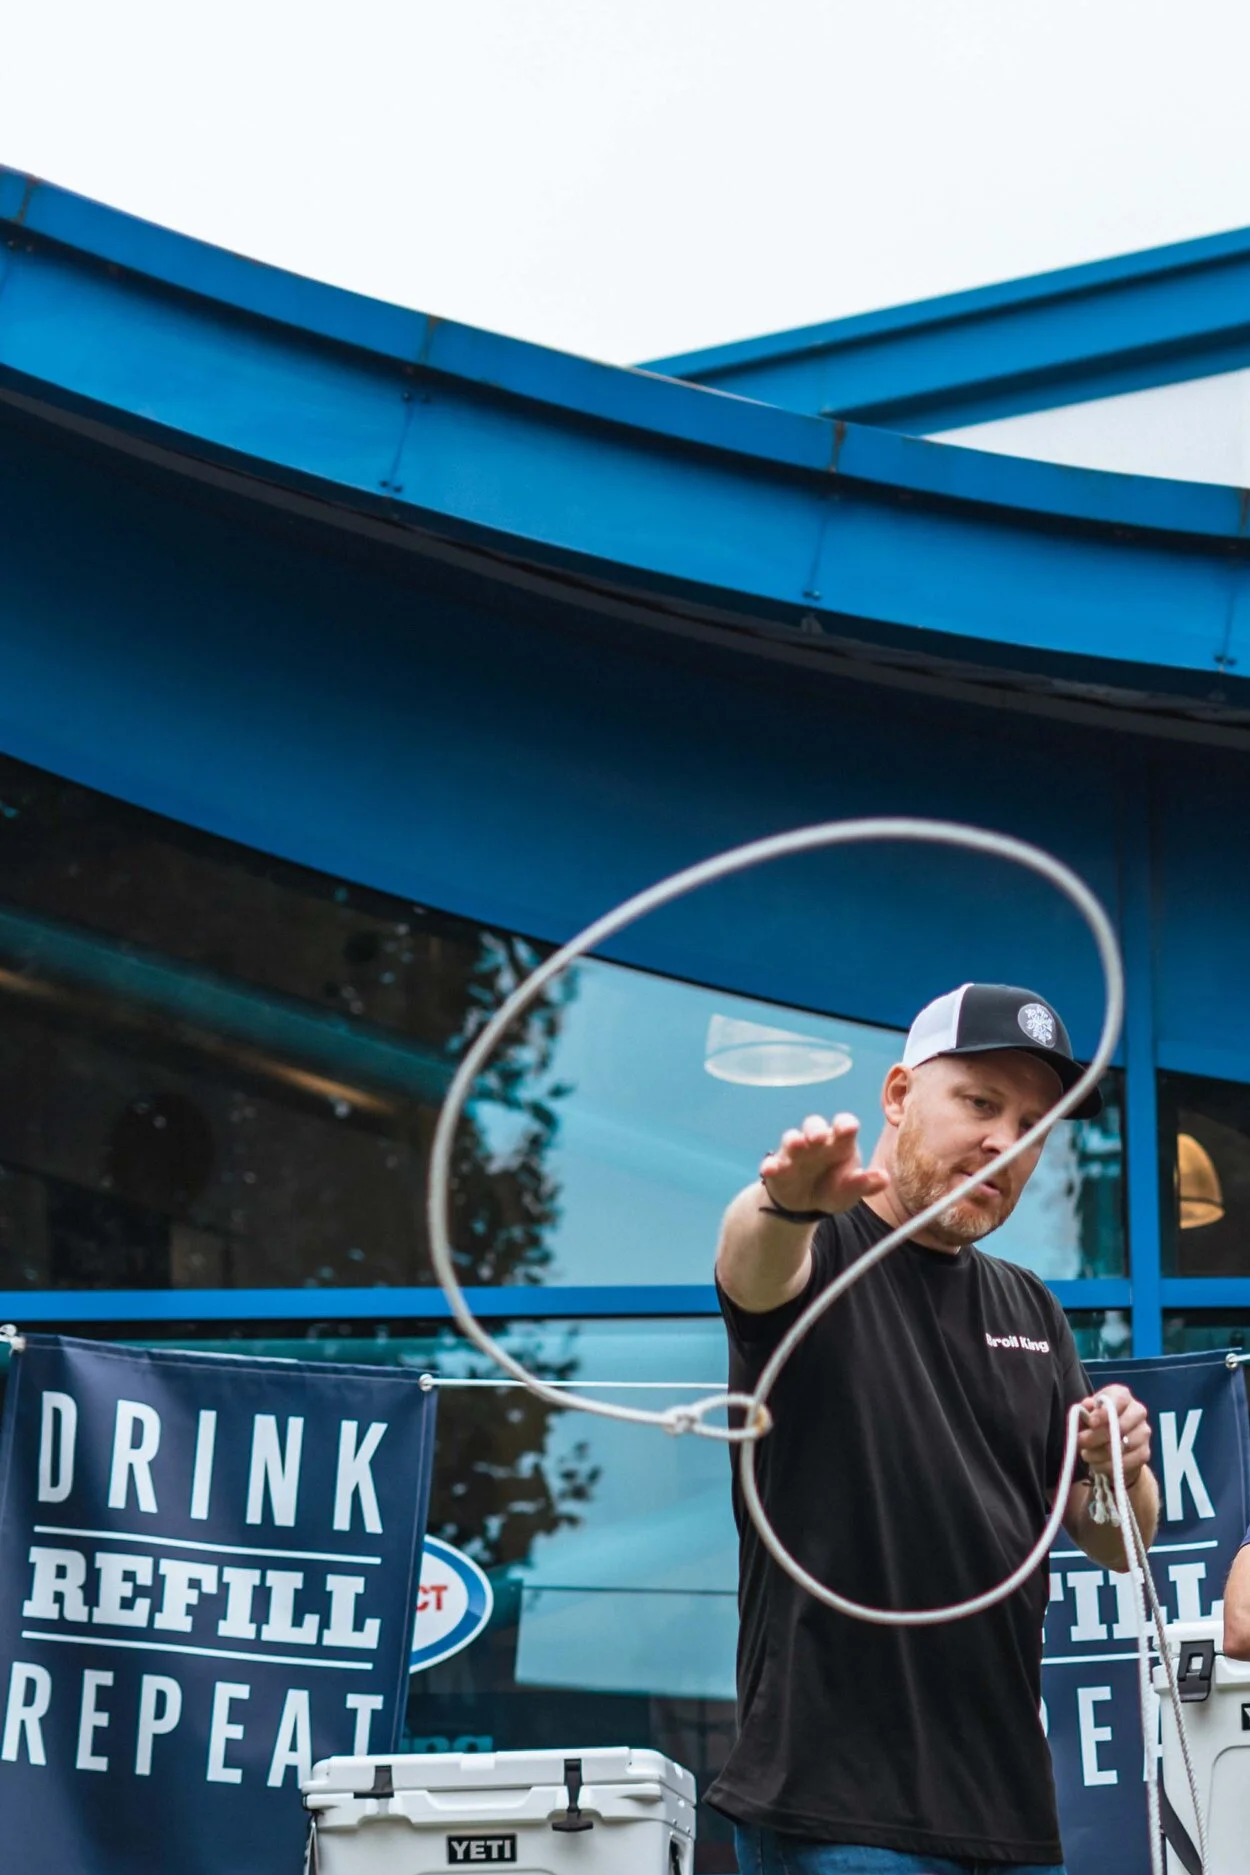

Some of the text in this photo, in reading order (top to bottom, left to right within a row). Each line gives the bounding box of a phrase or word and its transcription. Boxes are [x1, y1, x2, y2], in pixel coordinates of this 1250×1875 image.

[1019, 1336, 1050, 1353] King
[38, 1390, 388, 1535] DRINK
[22, 1545, 382, 1650] REFILL
[1, 1660, 384, 1789] REPEAT
[450, 1839, 512, 1860] YETI
